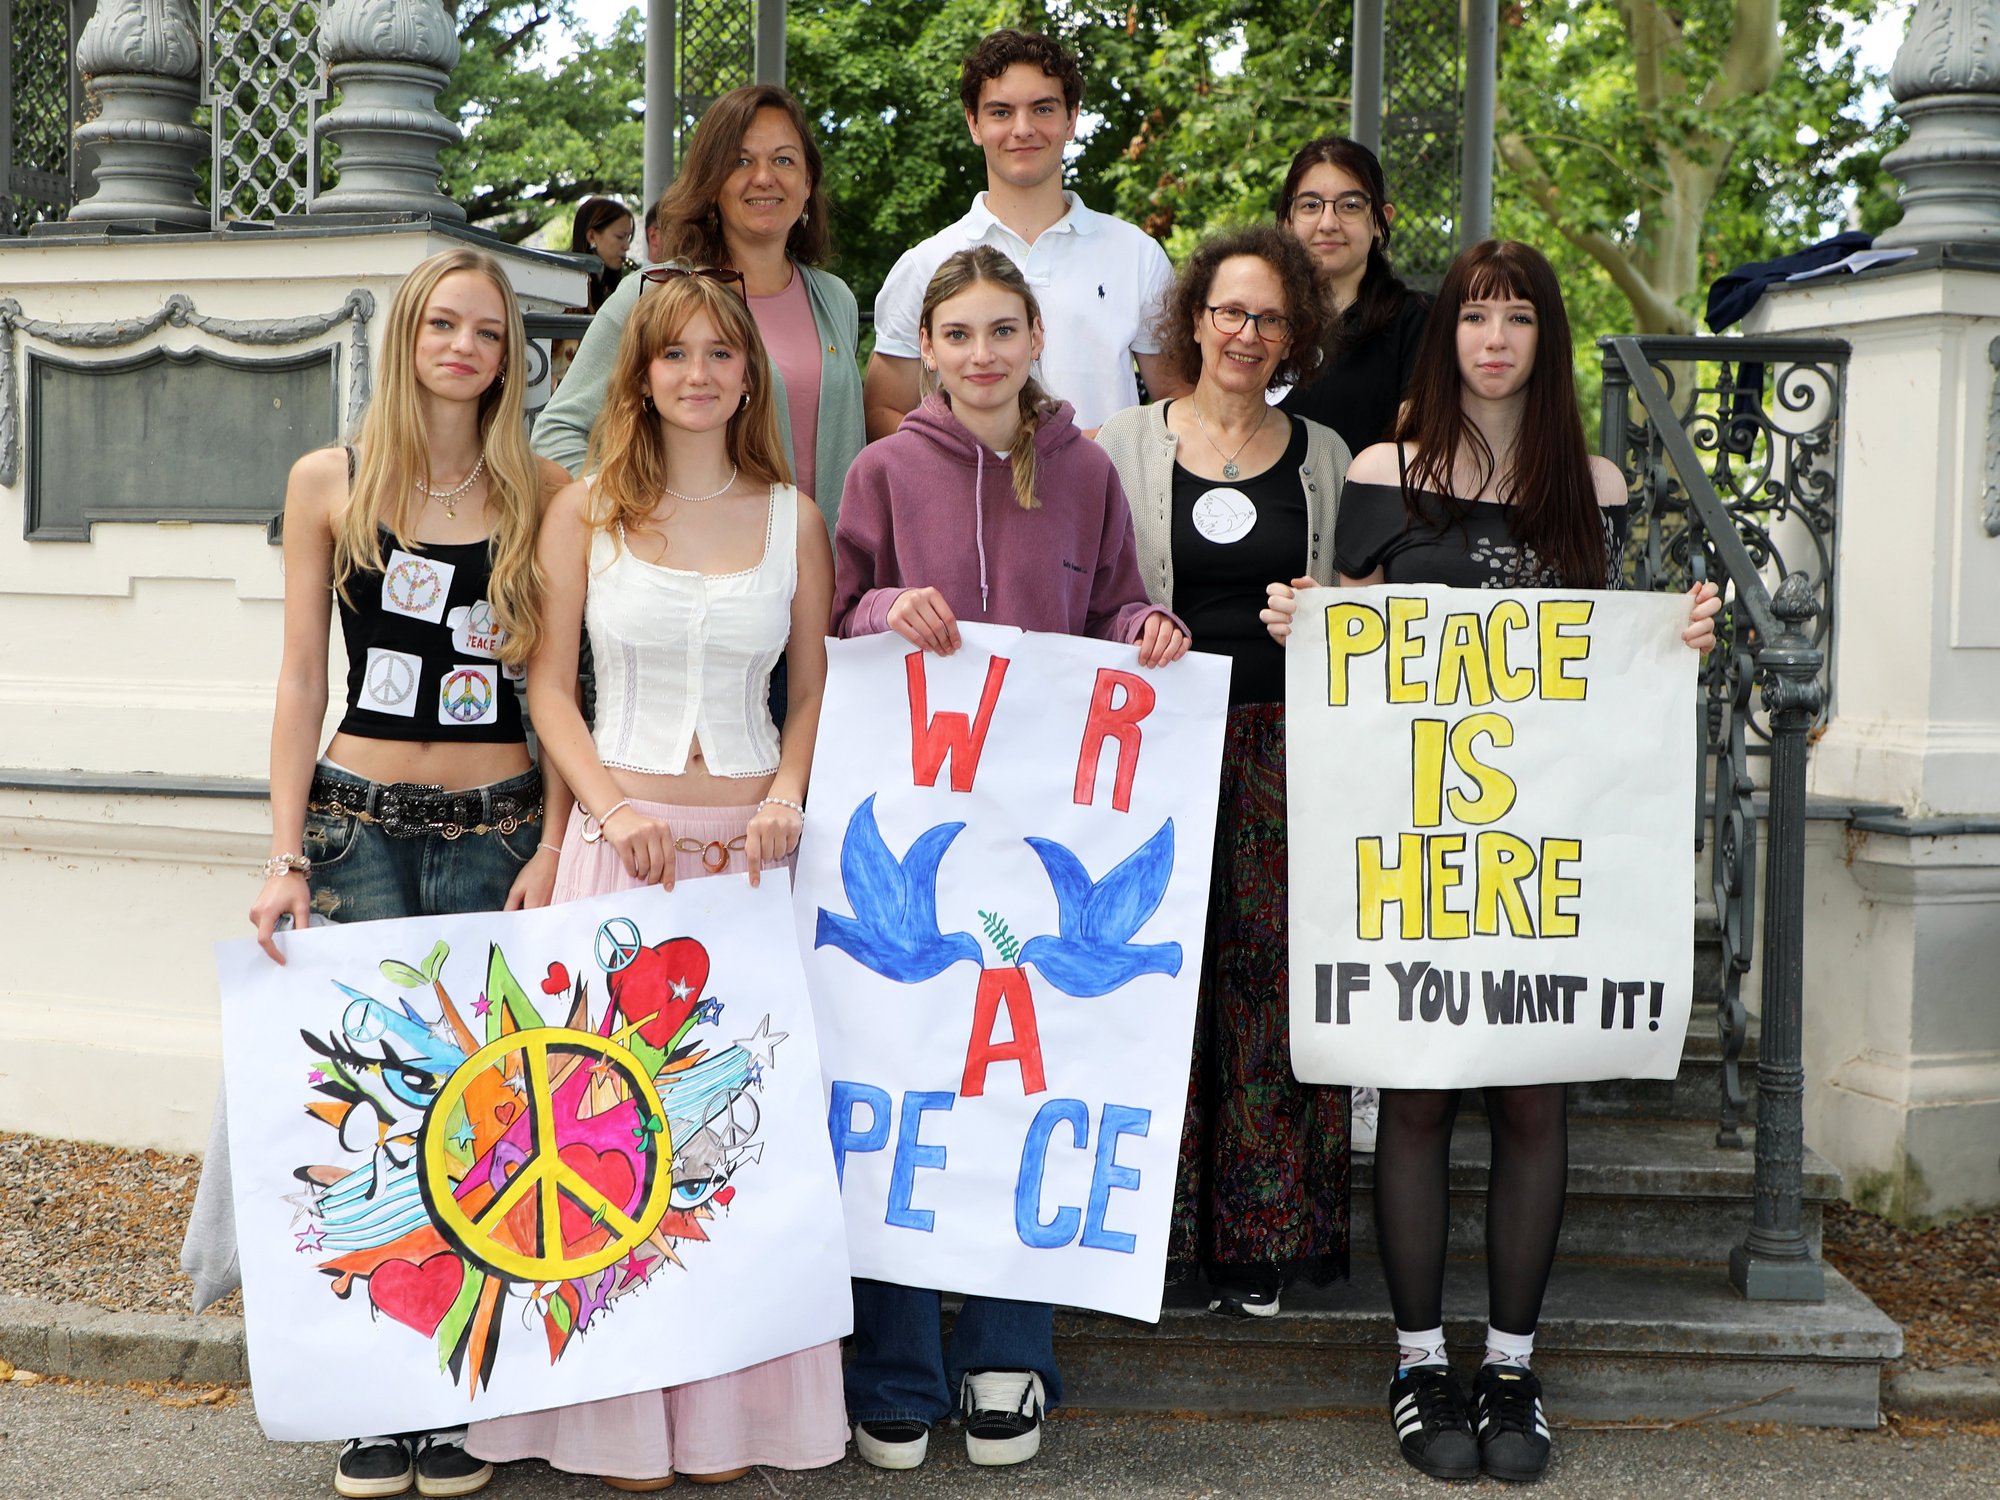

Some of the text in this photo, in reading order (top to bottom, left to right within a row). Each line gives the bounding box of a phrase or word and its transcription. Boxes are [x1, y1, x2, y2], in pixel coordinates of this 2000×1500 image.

[466, 634, 496, 651] PEACE
[1325, 597, 1595, 706] PEACE
[1411, 712, 1517, 828] IS
[1356, 831, 1582, 941] HERE
[1314, 961, 1665, 1032] IF YOU WANT IT!
